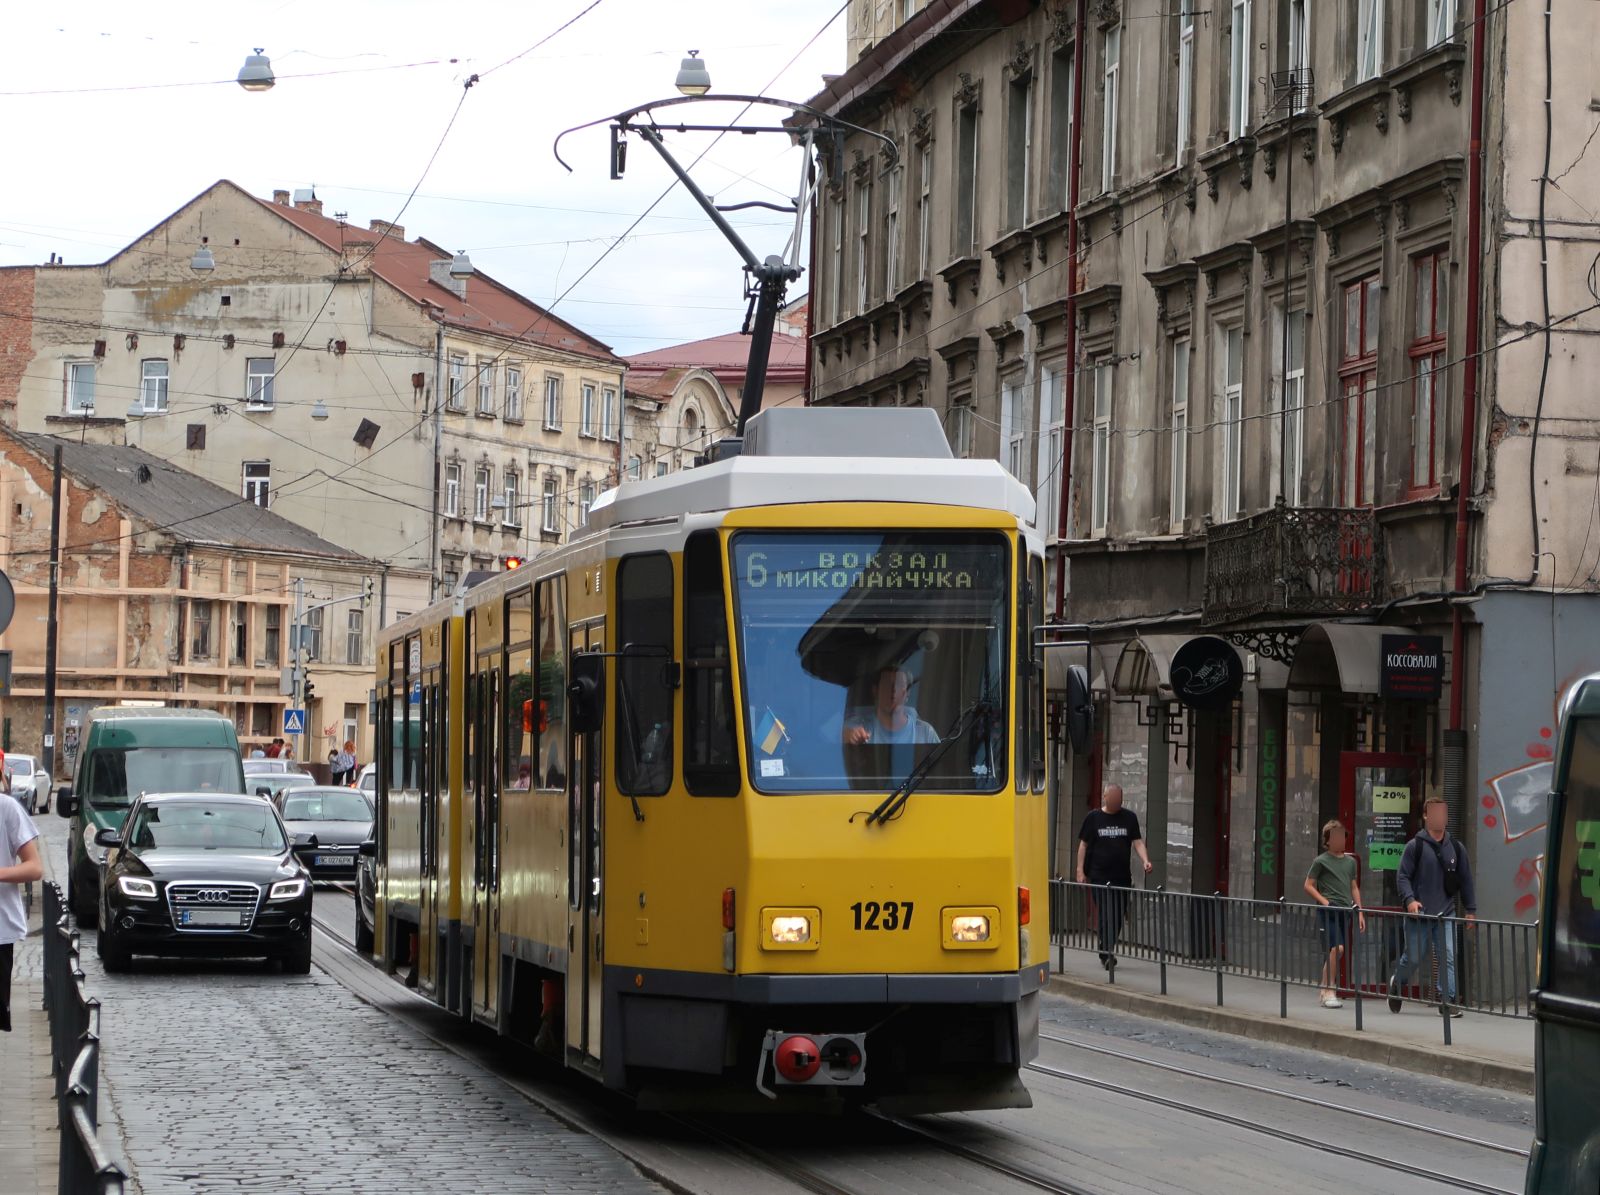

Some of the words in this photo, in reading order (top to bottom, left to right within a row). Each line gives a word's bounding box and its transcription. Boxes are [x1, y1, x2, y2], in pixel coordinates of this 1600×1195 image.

[747, 552, 767, 588] 6
[819, 552, 947, 569] ВОКЗАЛ
[776, 571, 972, 588] МИКОЛАЙЧУКА
[1260, 729, 1277, 875] EUROSTOCK
[1375, 791, 1407, 800] -20%
[850, 901, 914, 931] 1237
